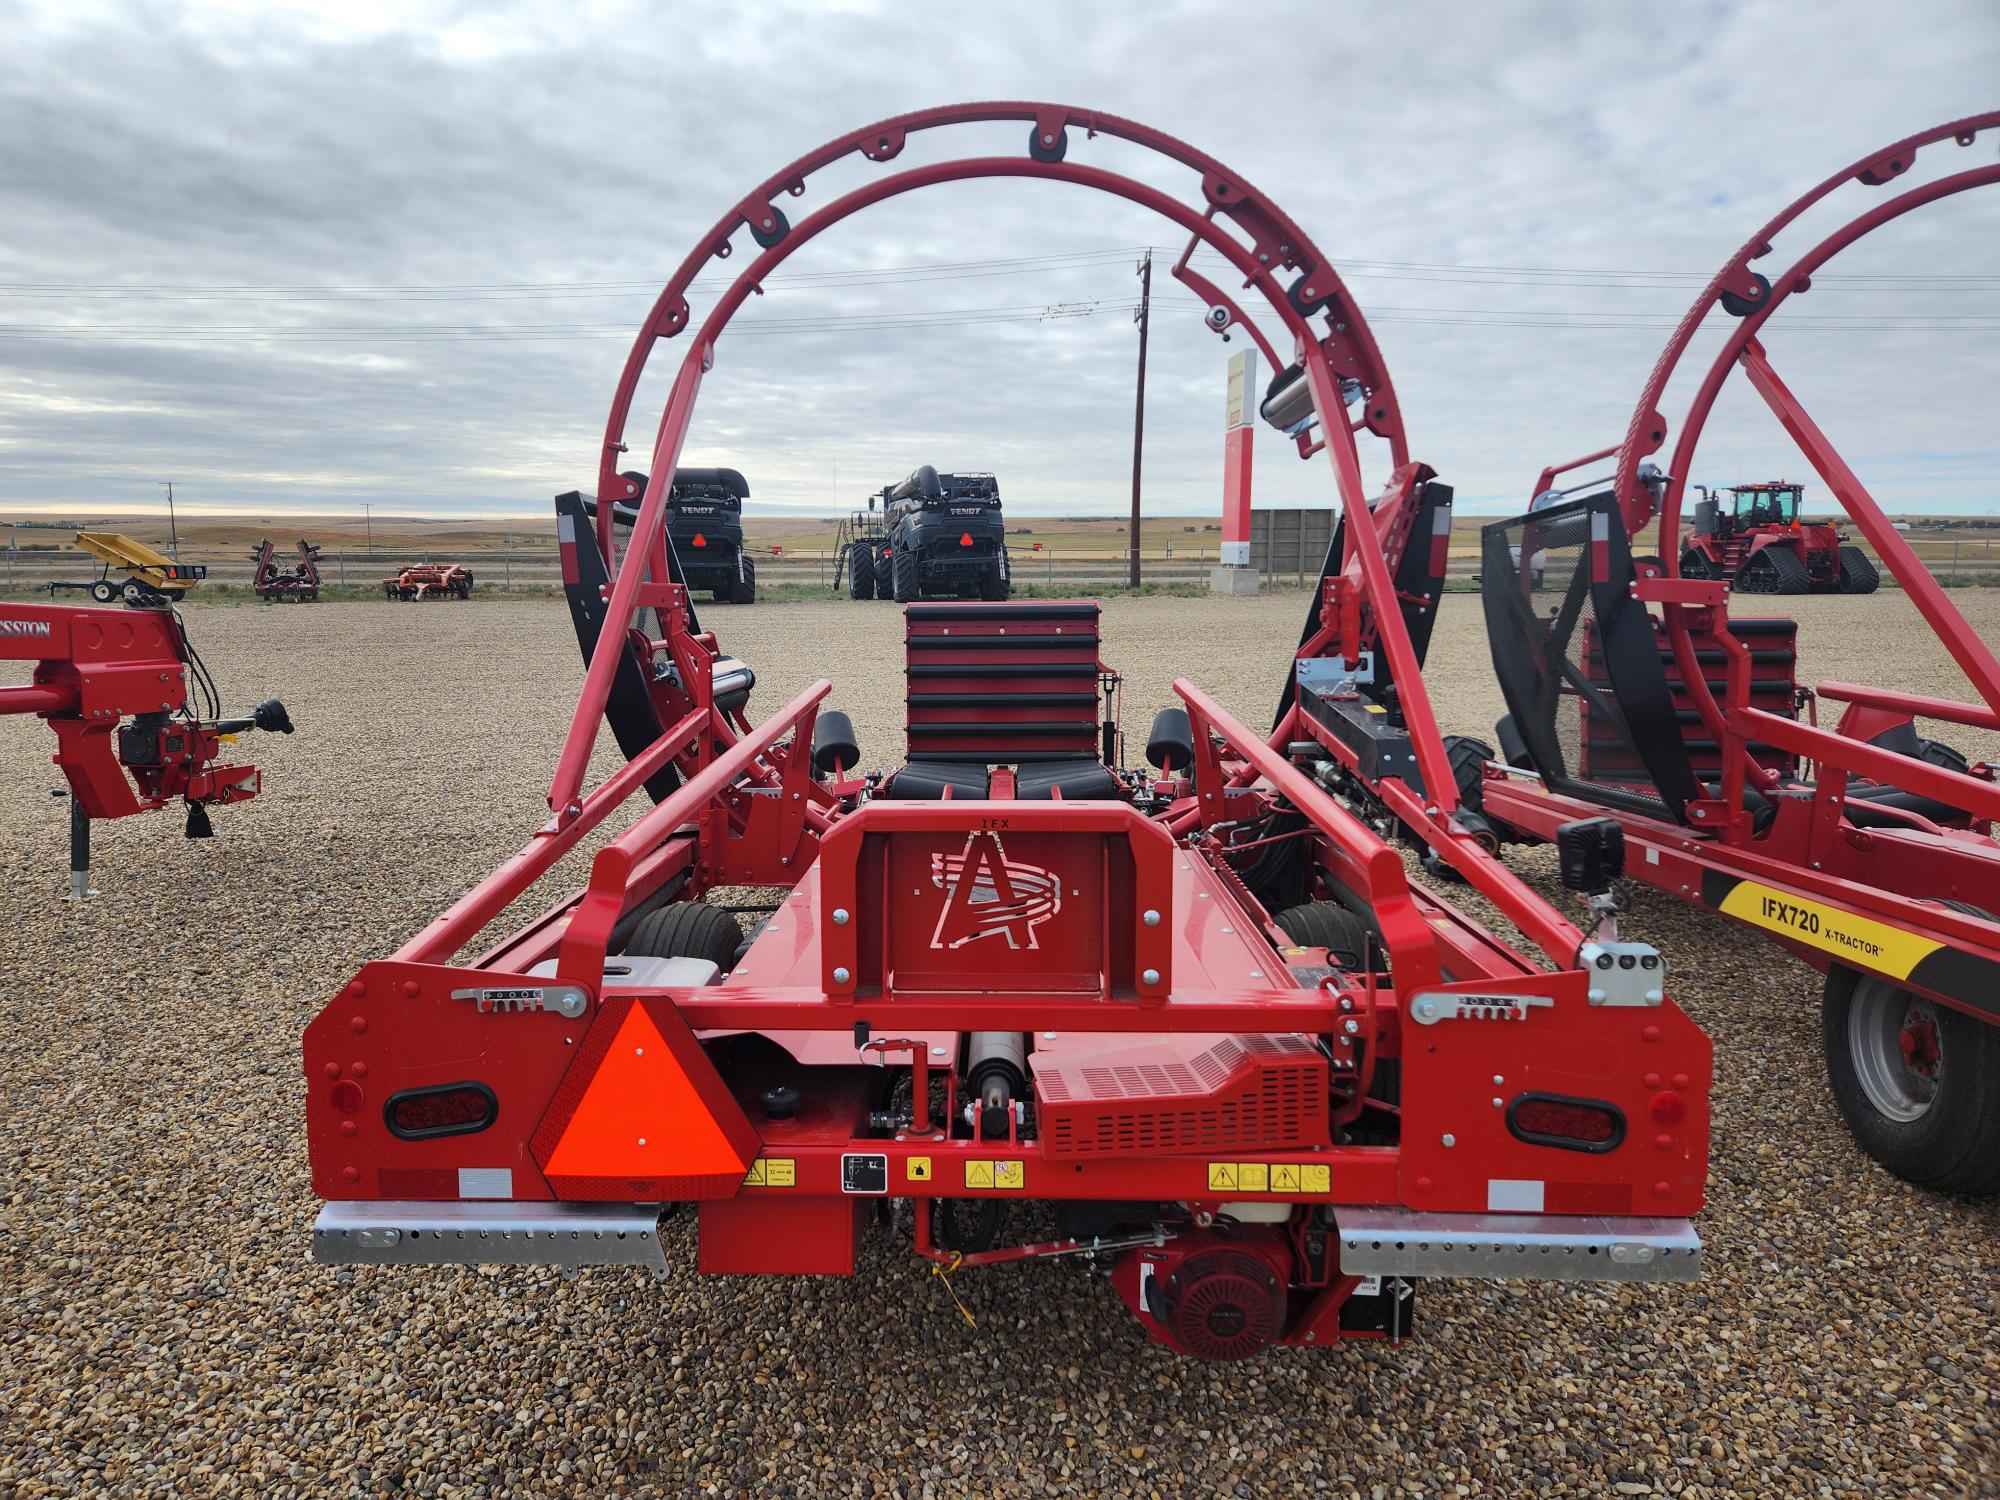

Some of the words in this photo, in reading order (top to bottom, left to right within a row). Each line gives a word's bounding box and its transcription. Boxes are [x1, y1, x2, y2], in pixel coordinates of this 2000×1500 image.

[681, 506, 715, 514] FENDT
[950, 507, 982, 515] FENDT
[982, 819, 1009, 829] IFX
[1762, 896, 1820, 934] IFX720
